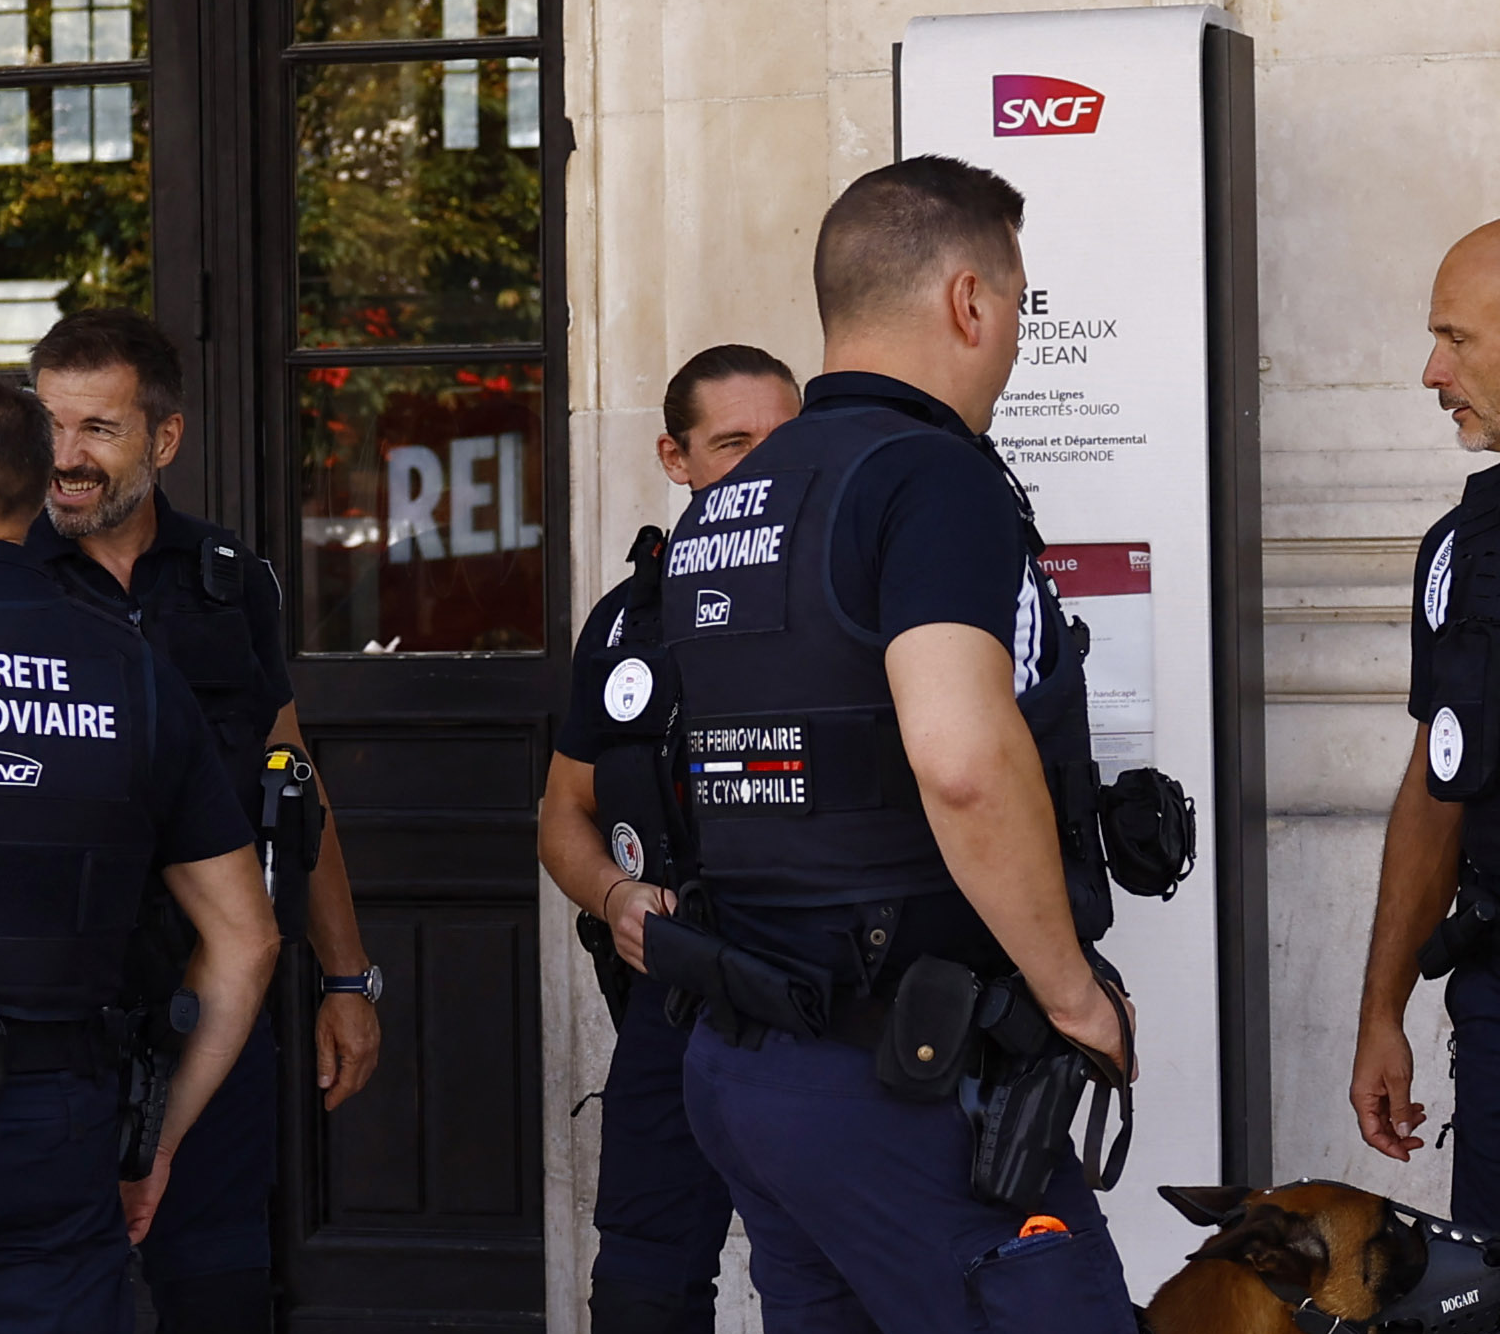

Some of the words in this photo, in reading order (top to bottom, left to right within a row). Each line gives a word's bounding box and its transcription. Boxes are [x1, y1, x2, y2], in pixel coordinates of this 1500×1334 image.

[998, 96, 1098, 130] SNCF
[1017, 290, 1049, 315] RE
[1016, 319, 1118, 341] ORDEAUX
[1001, 390, 1046, 402] Grandes
[1049, 389, 1085, 403] Lignes
[1001, 436, 1048, 450] Régional
[1050, 437, 1061, 447] et
[1065, 433, 1148, 449] Départemental
[1019, 449, 1115, 464] TRANSGIRONDE
[699, 479, 773, 525] SURETE
[668, 525, 785, 578] FERROVIAIRE
[1427, 572, 1439, 615] SURETE
[1434, 538, 1454, 572] FERRO
[699, 602, 729, 624] SNCF
[707, 727, 802, 752] FERROVIAIRE
[713, 778, 805, 805] CYNOPHILE
[1441, 1289, 1480, 1314] DOGART
